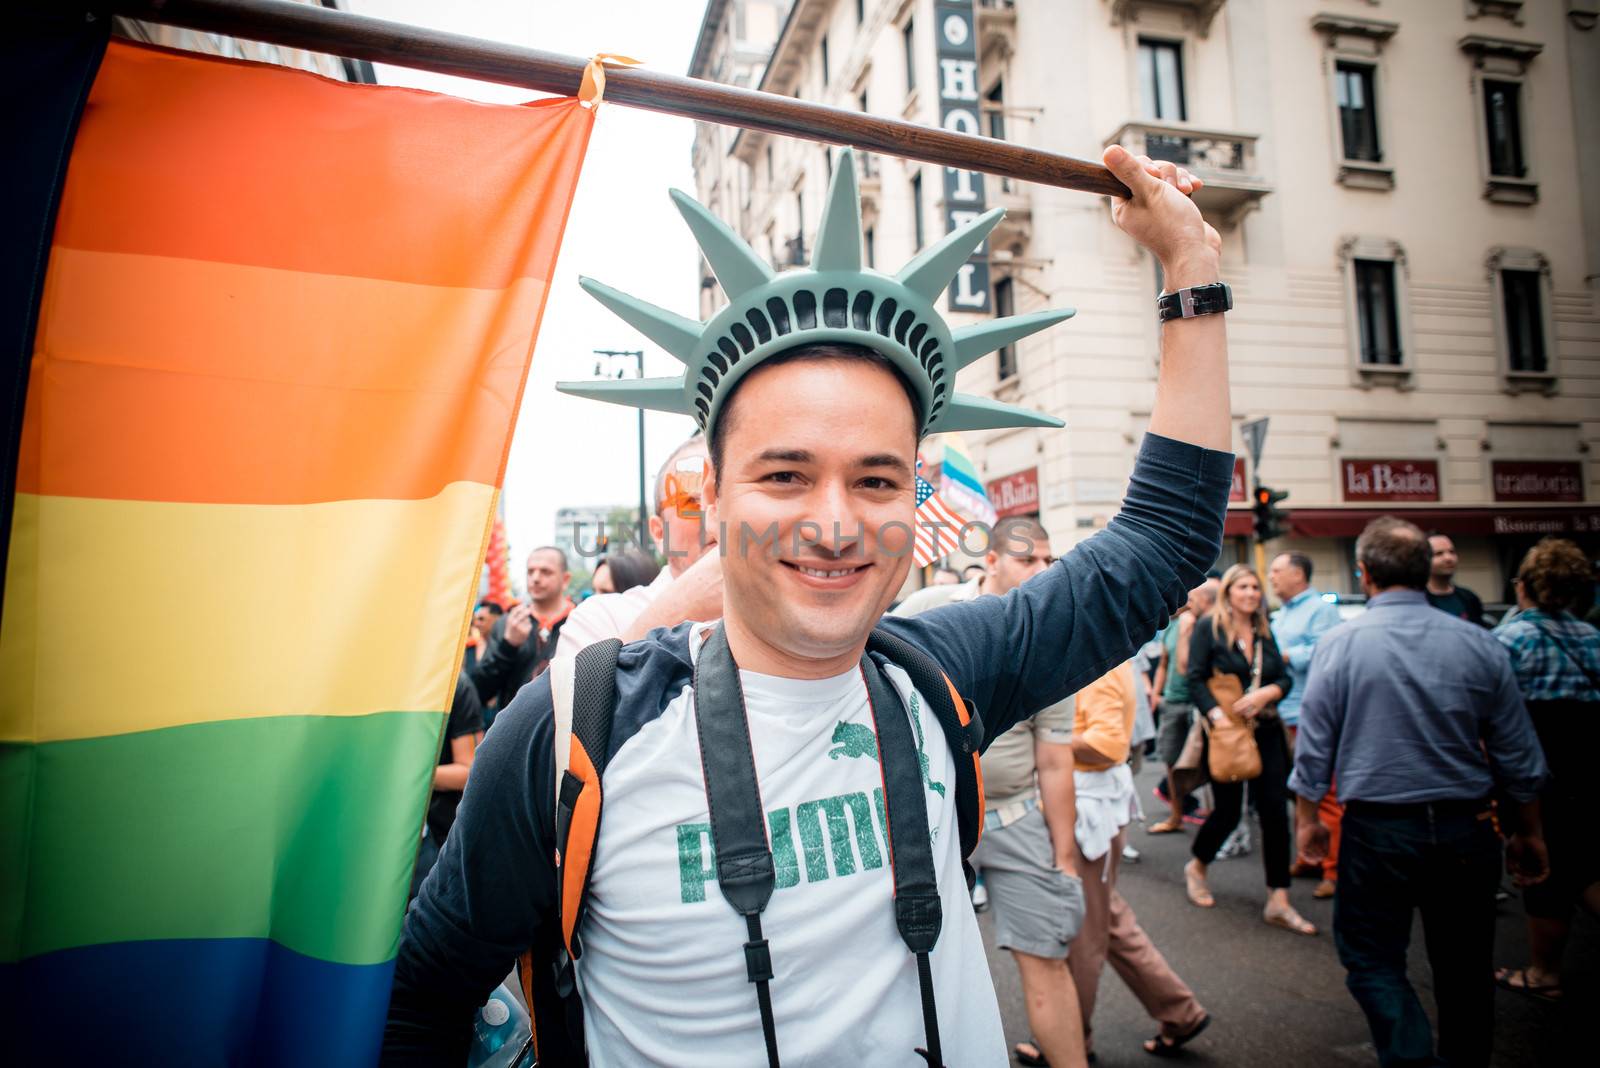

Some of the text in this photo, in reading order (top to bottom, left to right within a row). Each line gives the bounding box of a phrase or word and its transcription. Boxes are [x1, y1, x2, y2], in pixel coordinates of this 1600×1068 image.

[1347, 463, 1436, 494] la Baita
[1495, 467, 1580, 494] trattoria
